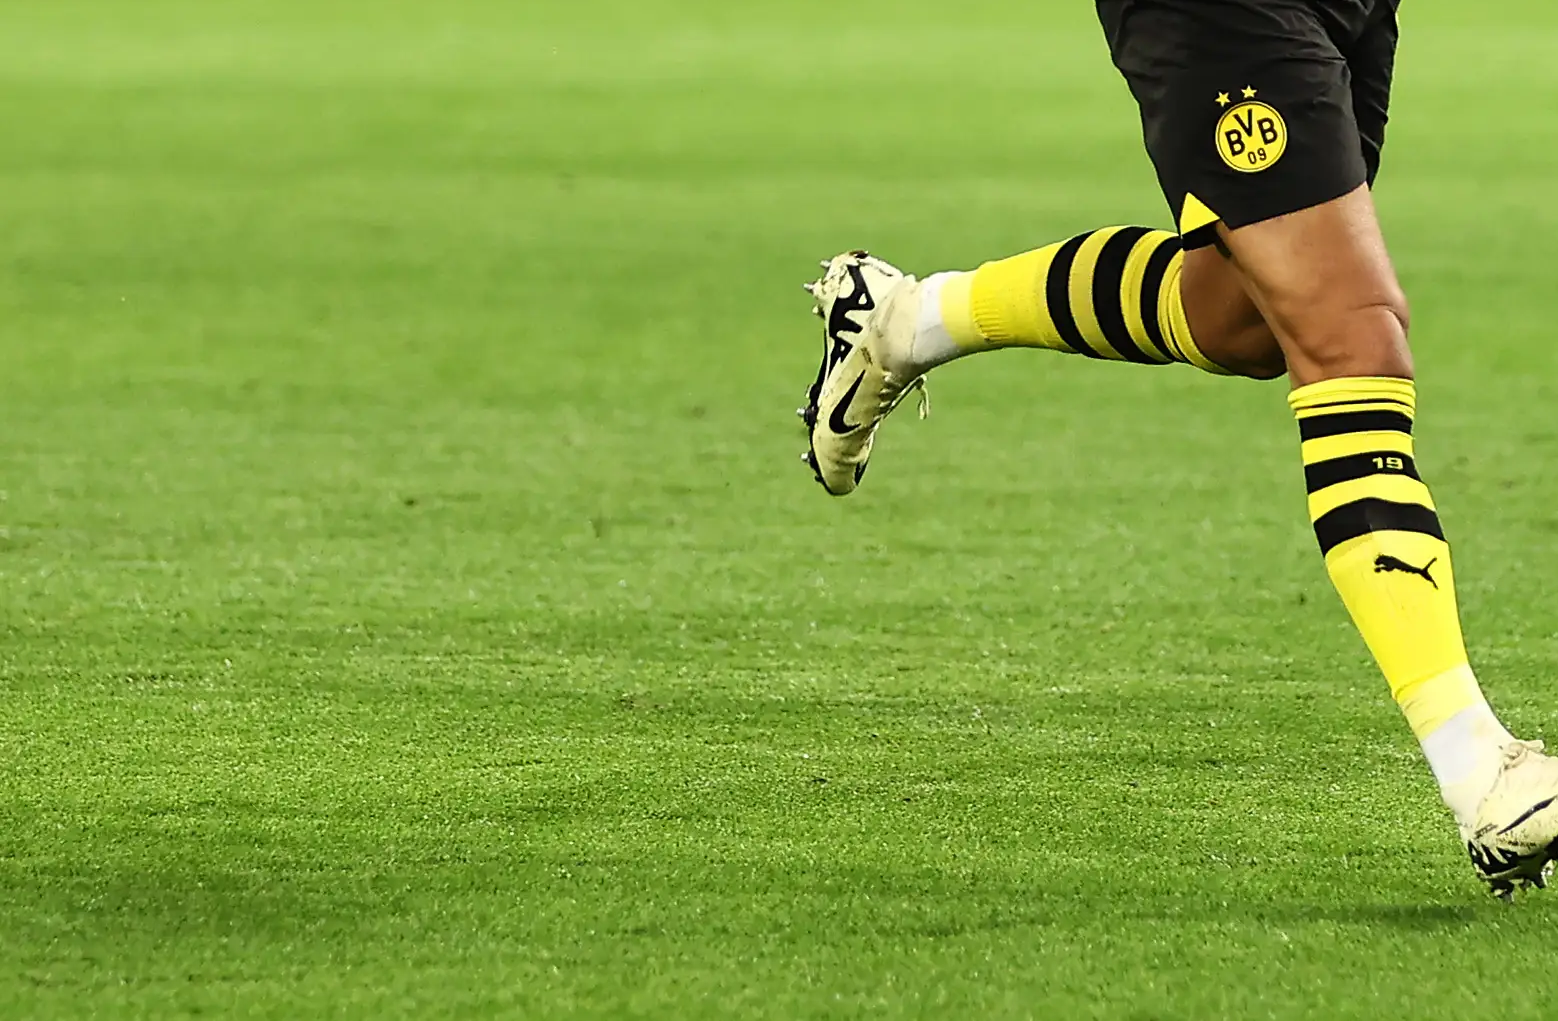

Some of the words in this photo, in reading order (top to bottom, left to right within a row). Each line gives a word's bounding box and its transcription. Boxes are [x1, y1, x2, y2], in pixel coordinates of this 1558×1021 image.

[1224, 108, 1279, 157] BVB
[1247, 147, 1267, 165] 09
[1372, 456, 1405, 470] 19
